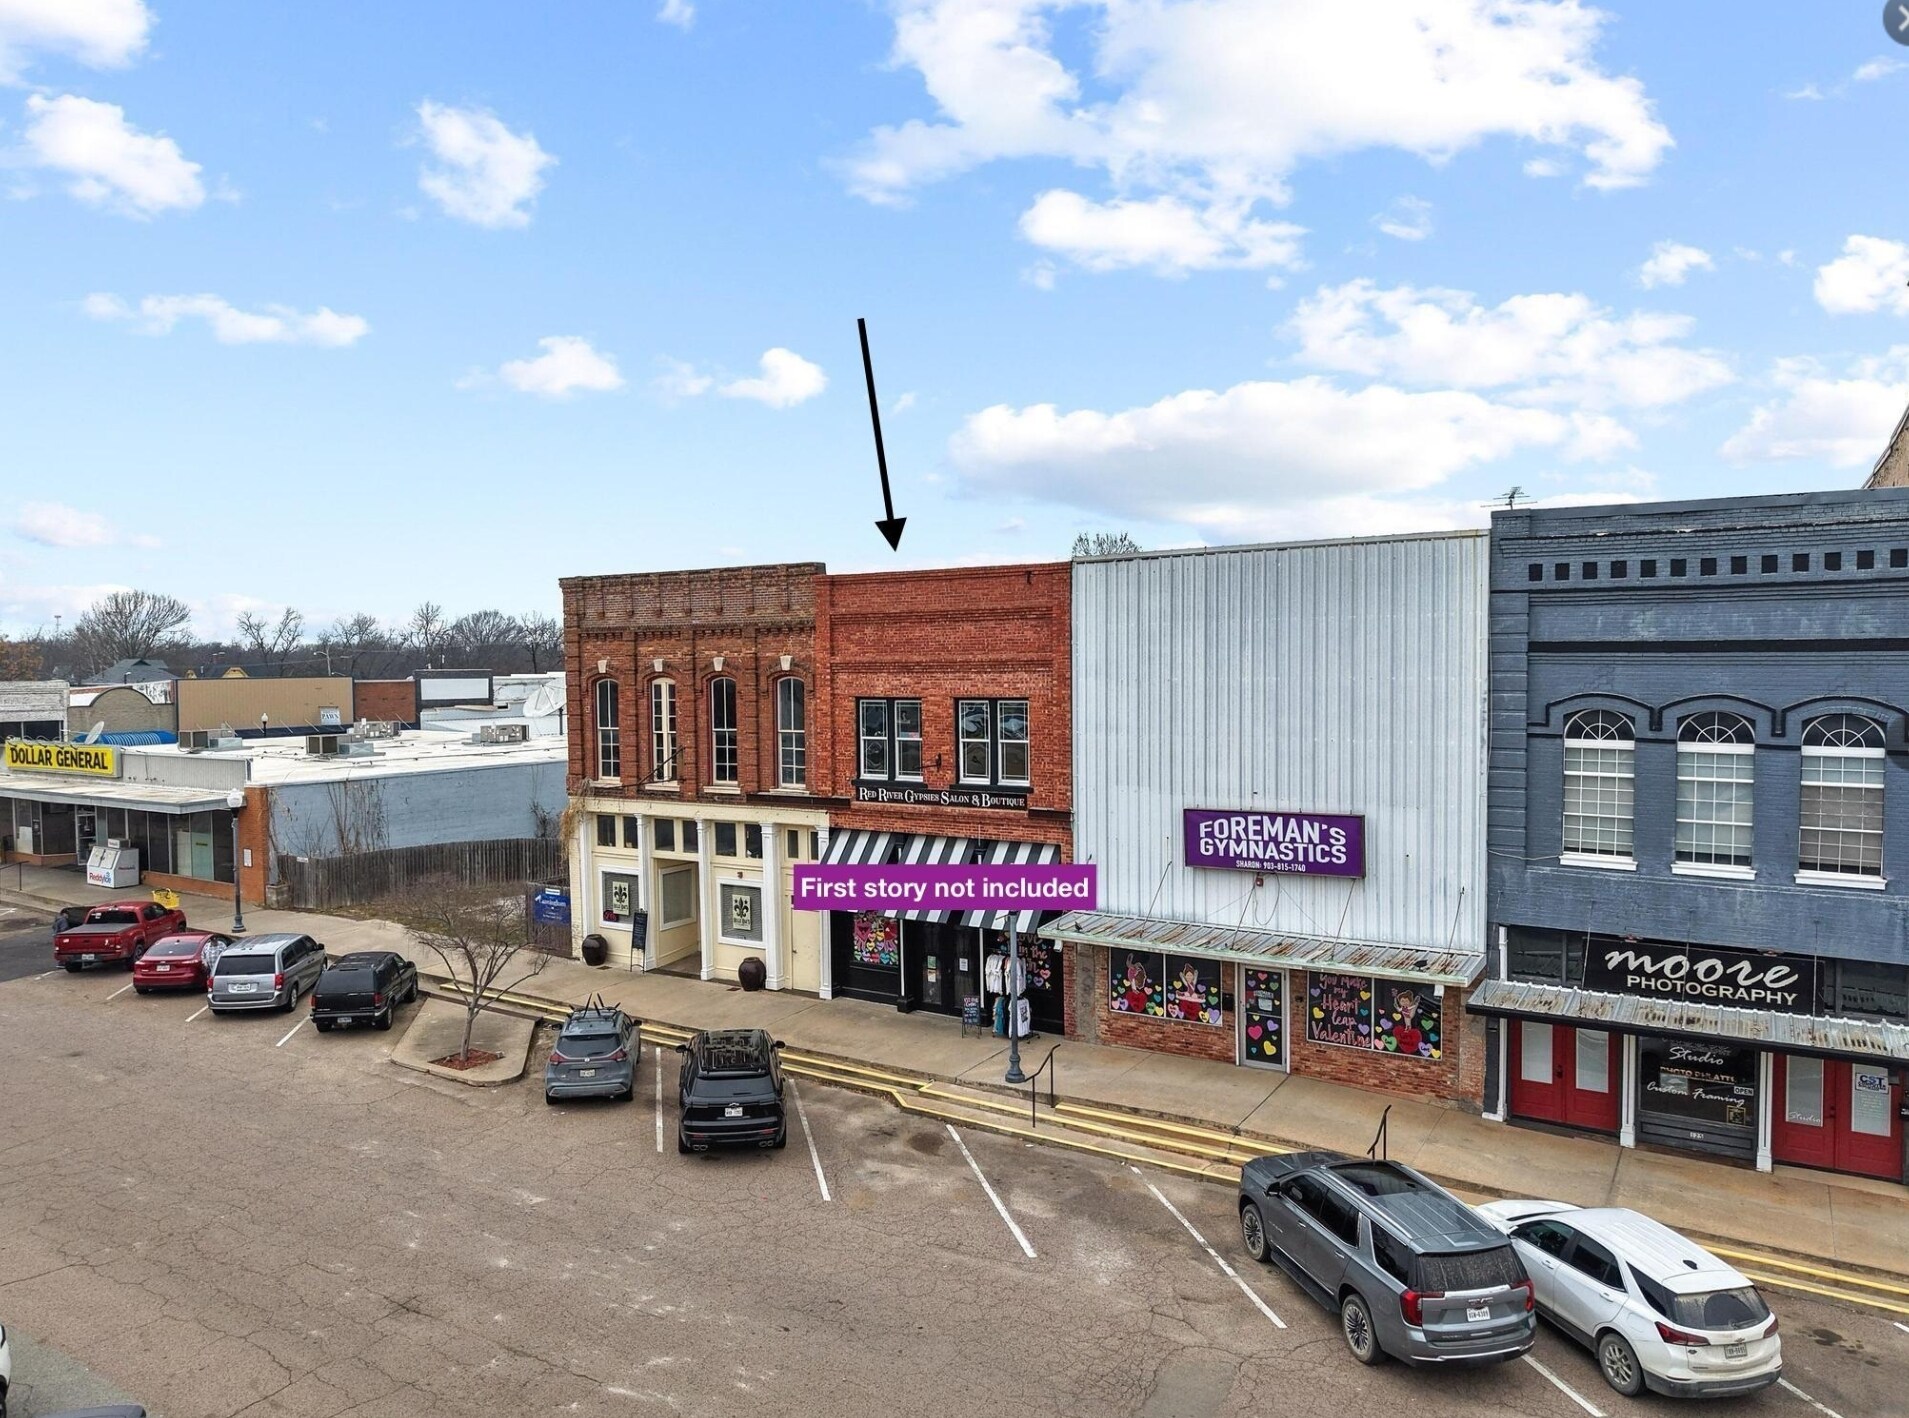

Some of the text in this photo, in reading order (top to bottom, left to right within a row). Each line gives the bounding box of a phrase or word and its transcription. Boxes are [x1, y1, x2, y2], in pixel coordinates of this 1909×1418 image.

[10, 747, 108, 770] DOLLAR GENERAL
[859, 787, 1025, 807] RED RIVER GYPSIES SALON & BOUTIQUE
[1199, 815, 1347, 846] FOREMAN'S
[1200, 837, 1347, 864] GYMNASTICS
[1605, 950, 1799, 988] moore
[1626, 975, 1799, 1005] PHOTOGRAPHY
[1311, 1020, 1371, 1048] Valentine
[1668, 1046, 1724, 1065] Studio
[1646, 1081, 1745, 1108] Custom Framing
[1735, 1086, 1754, 1095] OPEN
[1789, 1111, 1821, 1123] Studio
